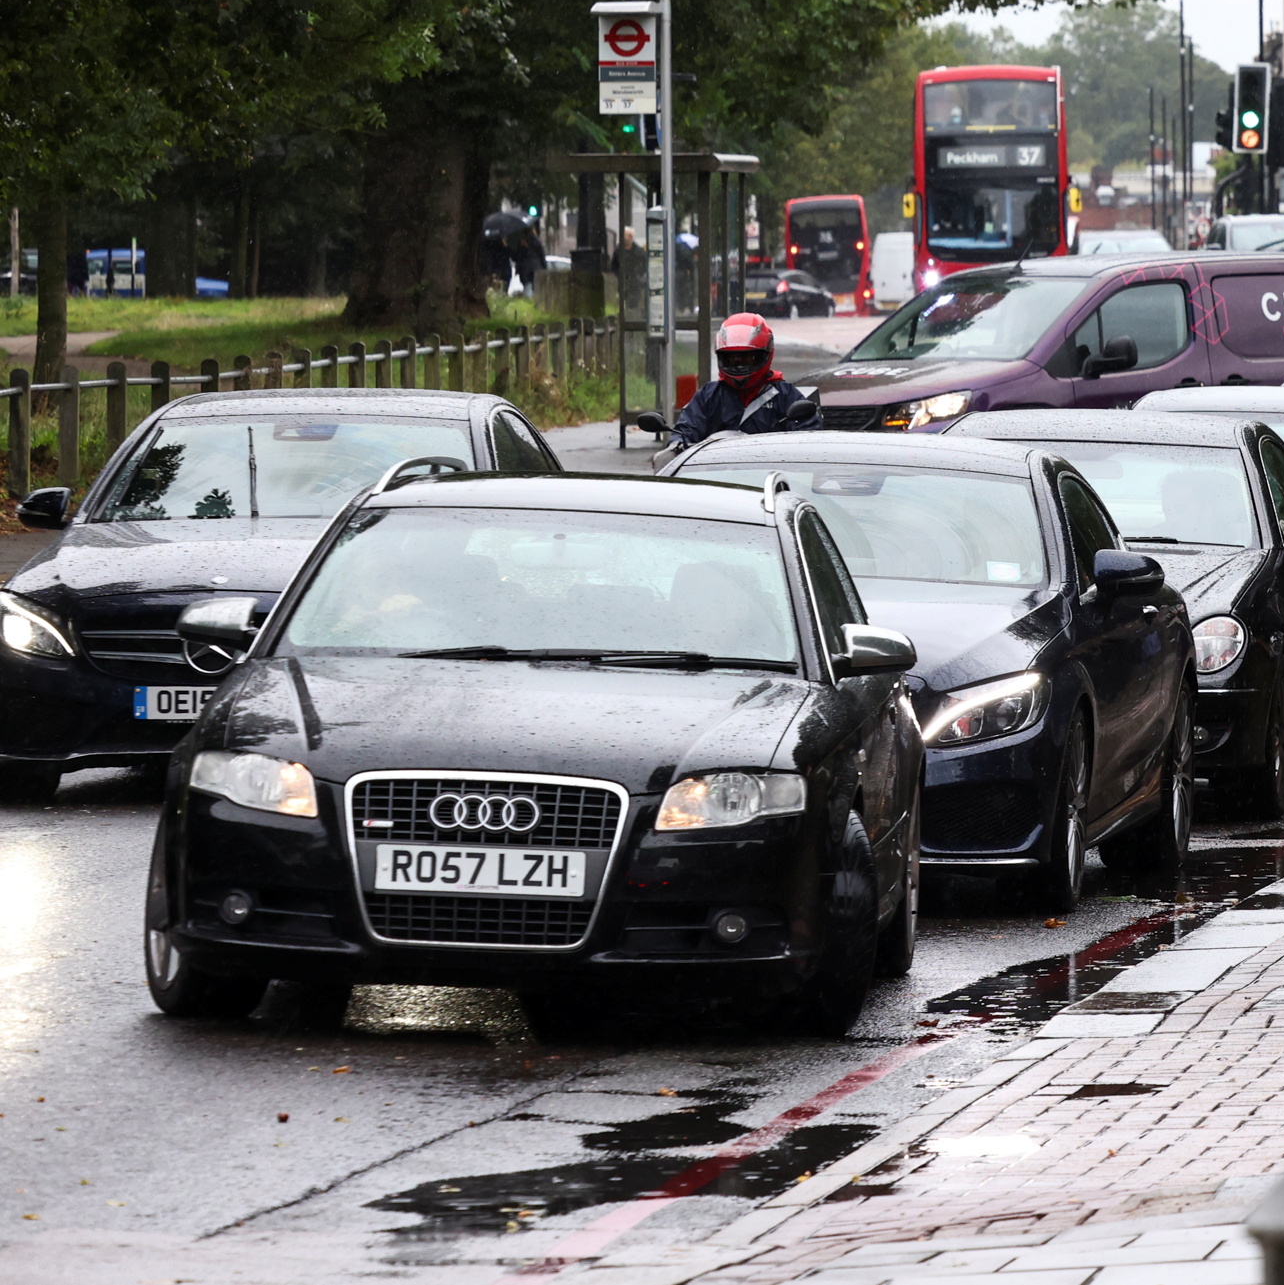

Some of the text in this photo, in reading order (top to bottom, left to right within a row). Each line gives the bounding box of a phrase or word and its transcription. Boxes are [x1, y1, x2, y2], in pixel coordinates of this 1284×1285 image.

[946, 146, 1041, 166] Peckham 37
[391, 849, 570, 888] RO57 LZH
